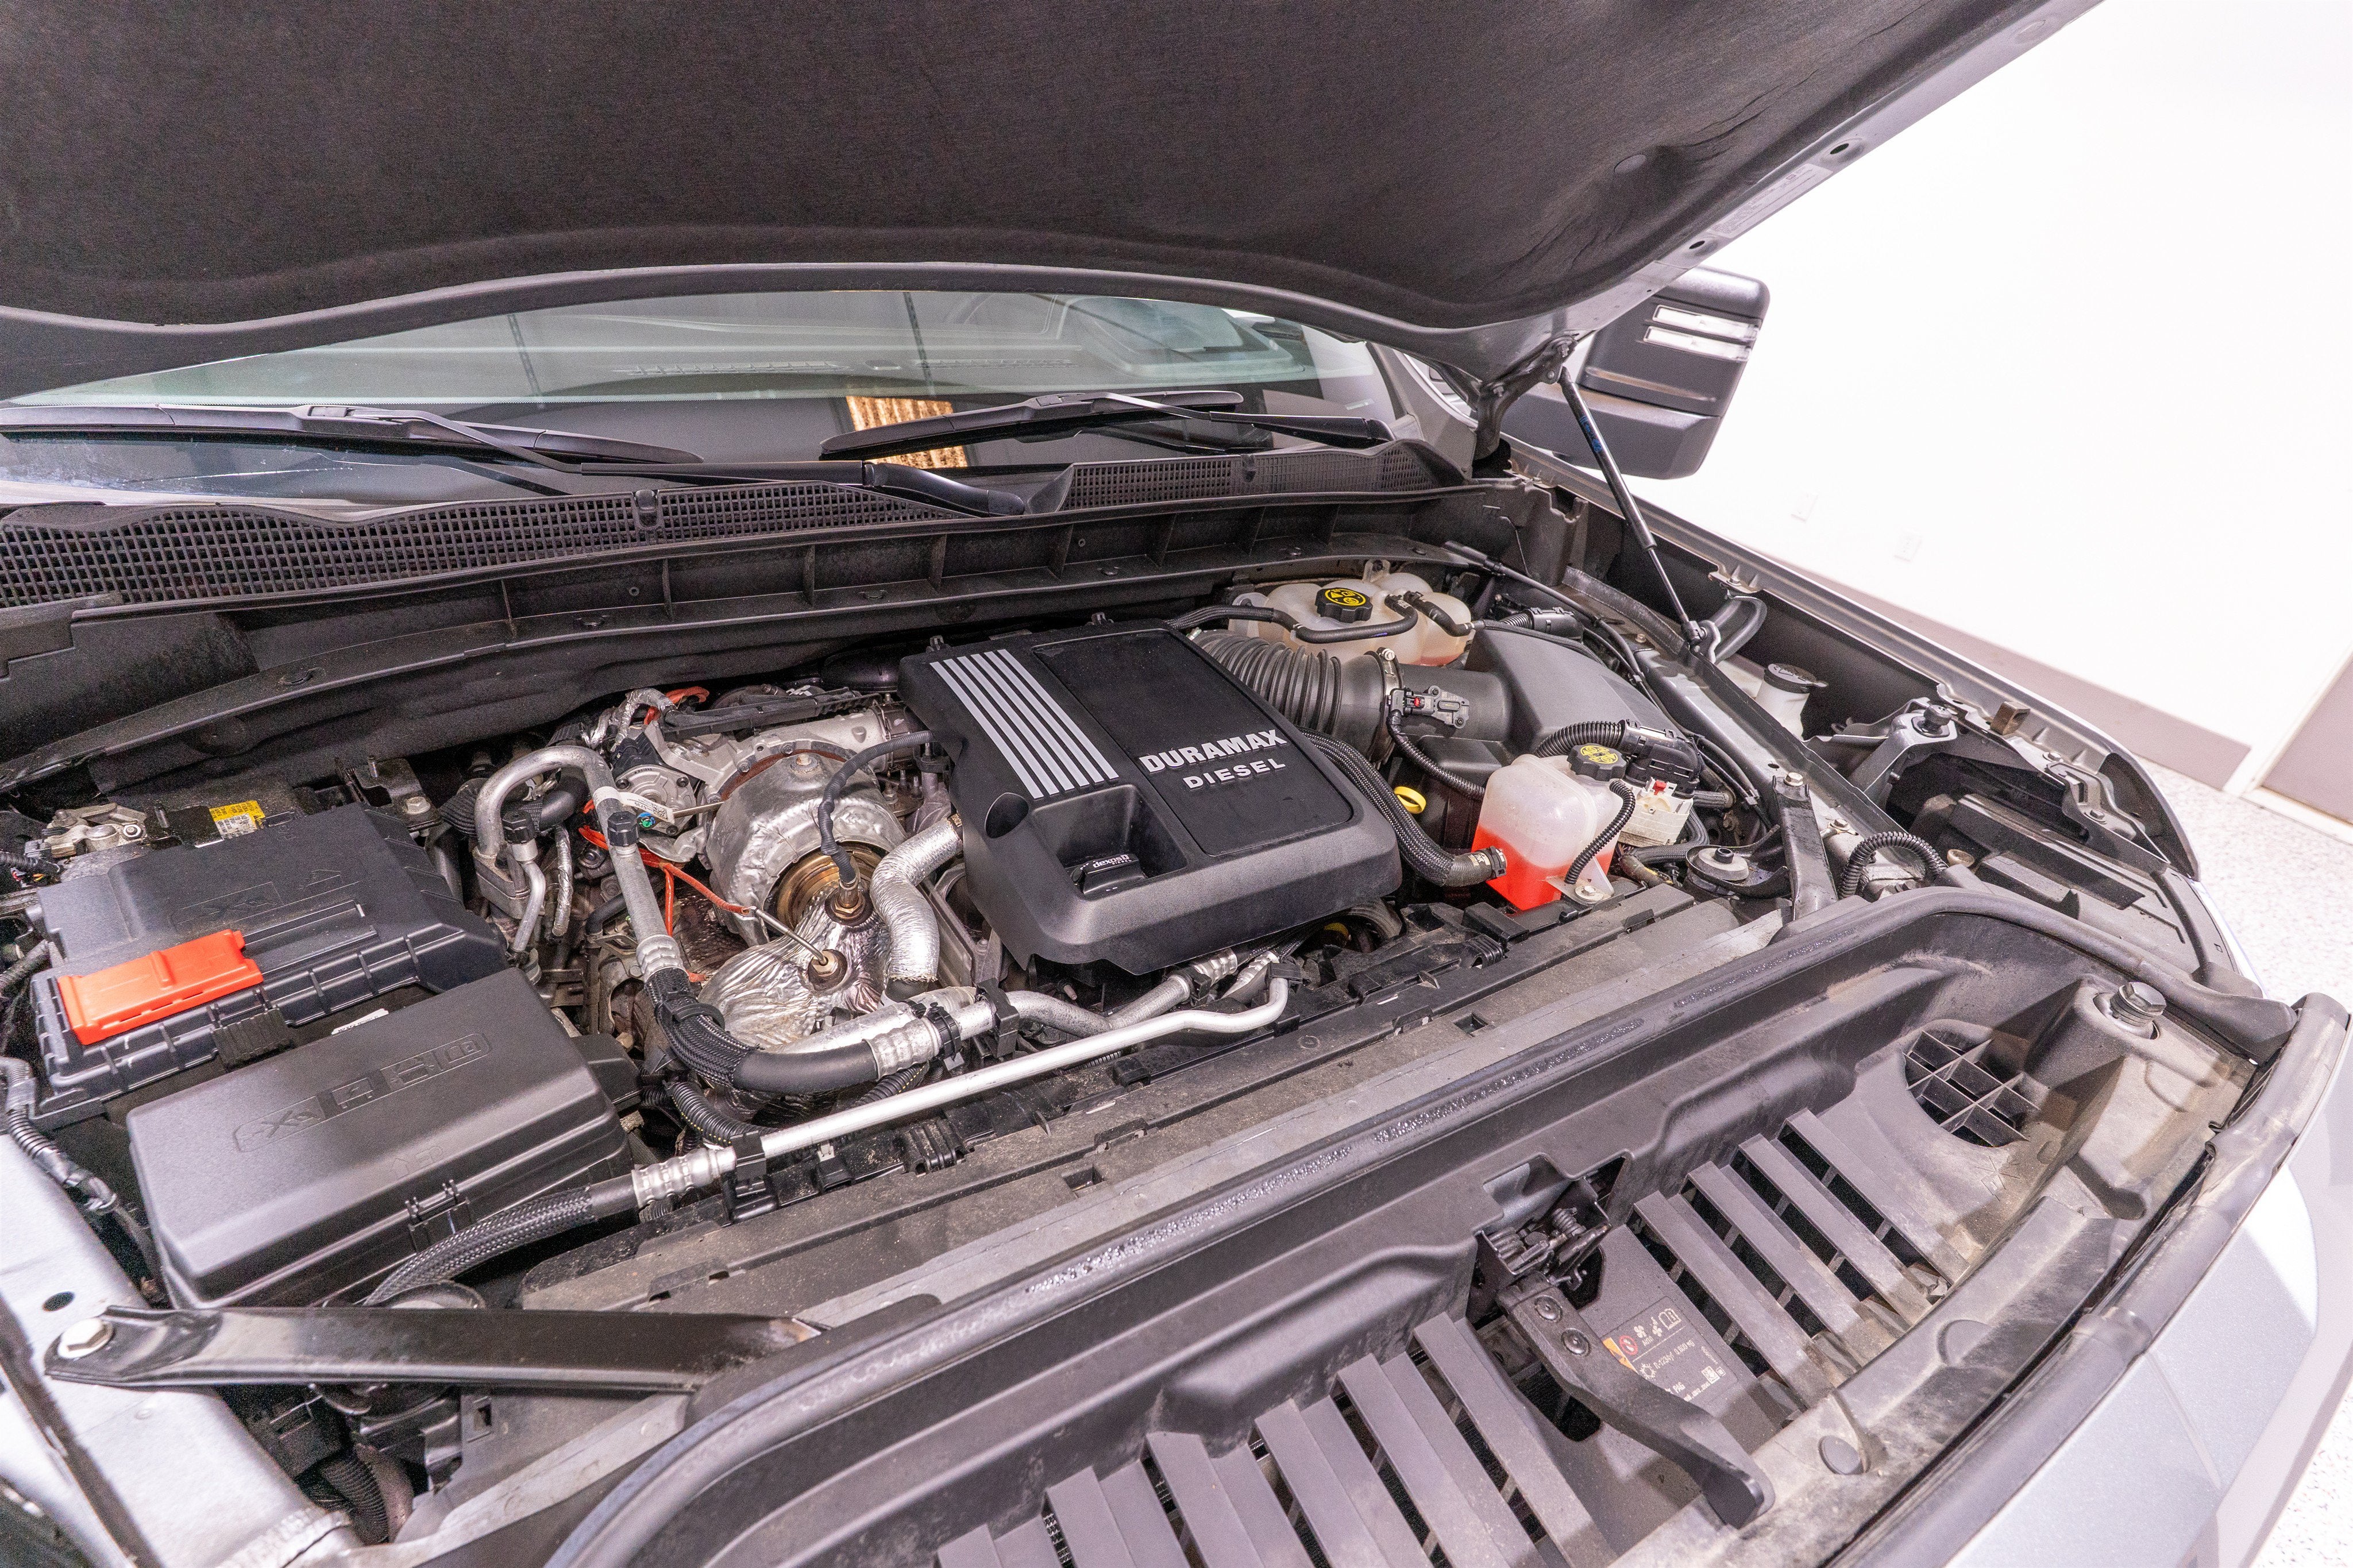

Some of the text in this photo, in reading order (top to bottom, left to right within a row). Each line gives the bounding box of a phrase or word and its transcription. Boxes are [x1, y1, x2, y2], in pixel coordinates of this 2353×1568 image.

[1139, 729, 1287, 773] DURAMAX
[1183, 758, 1286, 790] DIESEL
[1672, 1381, 1686, 1394] PAG
